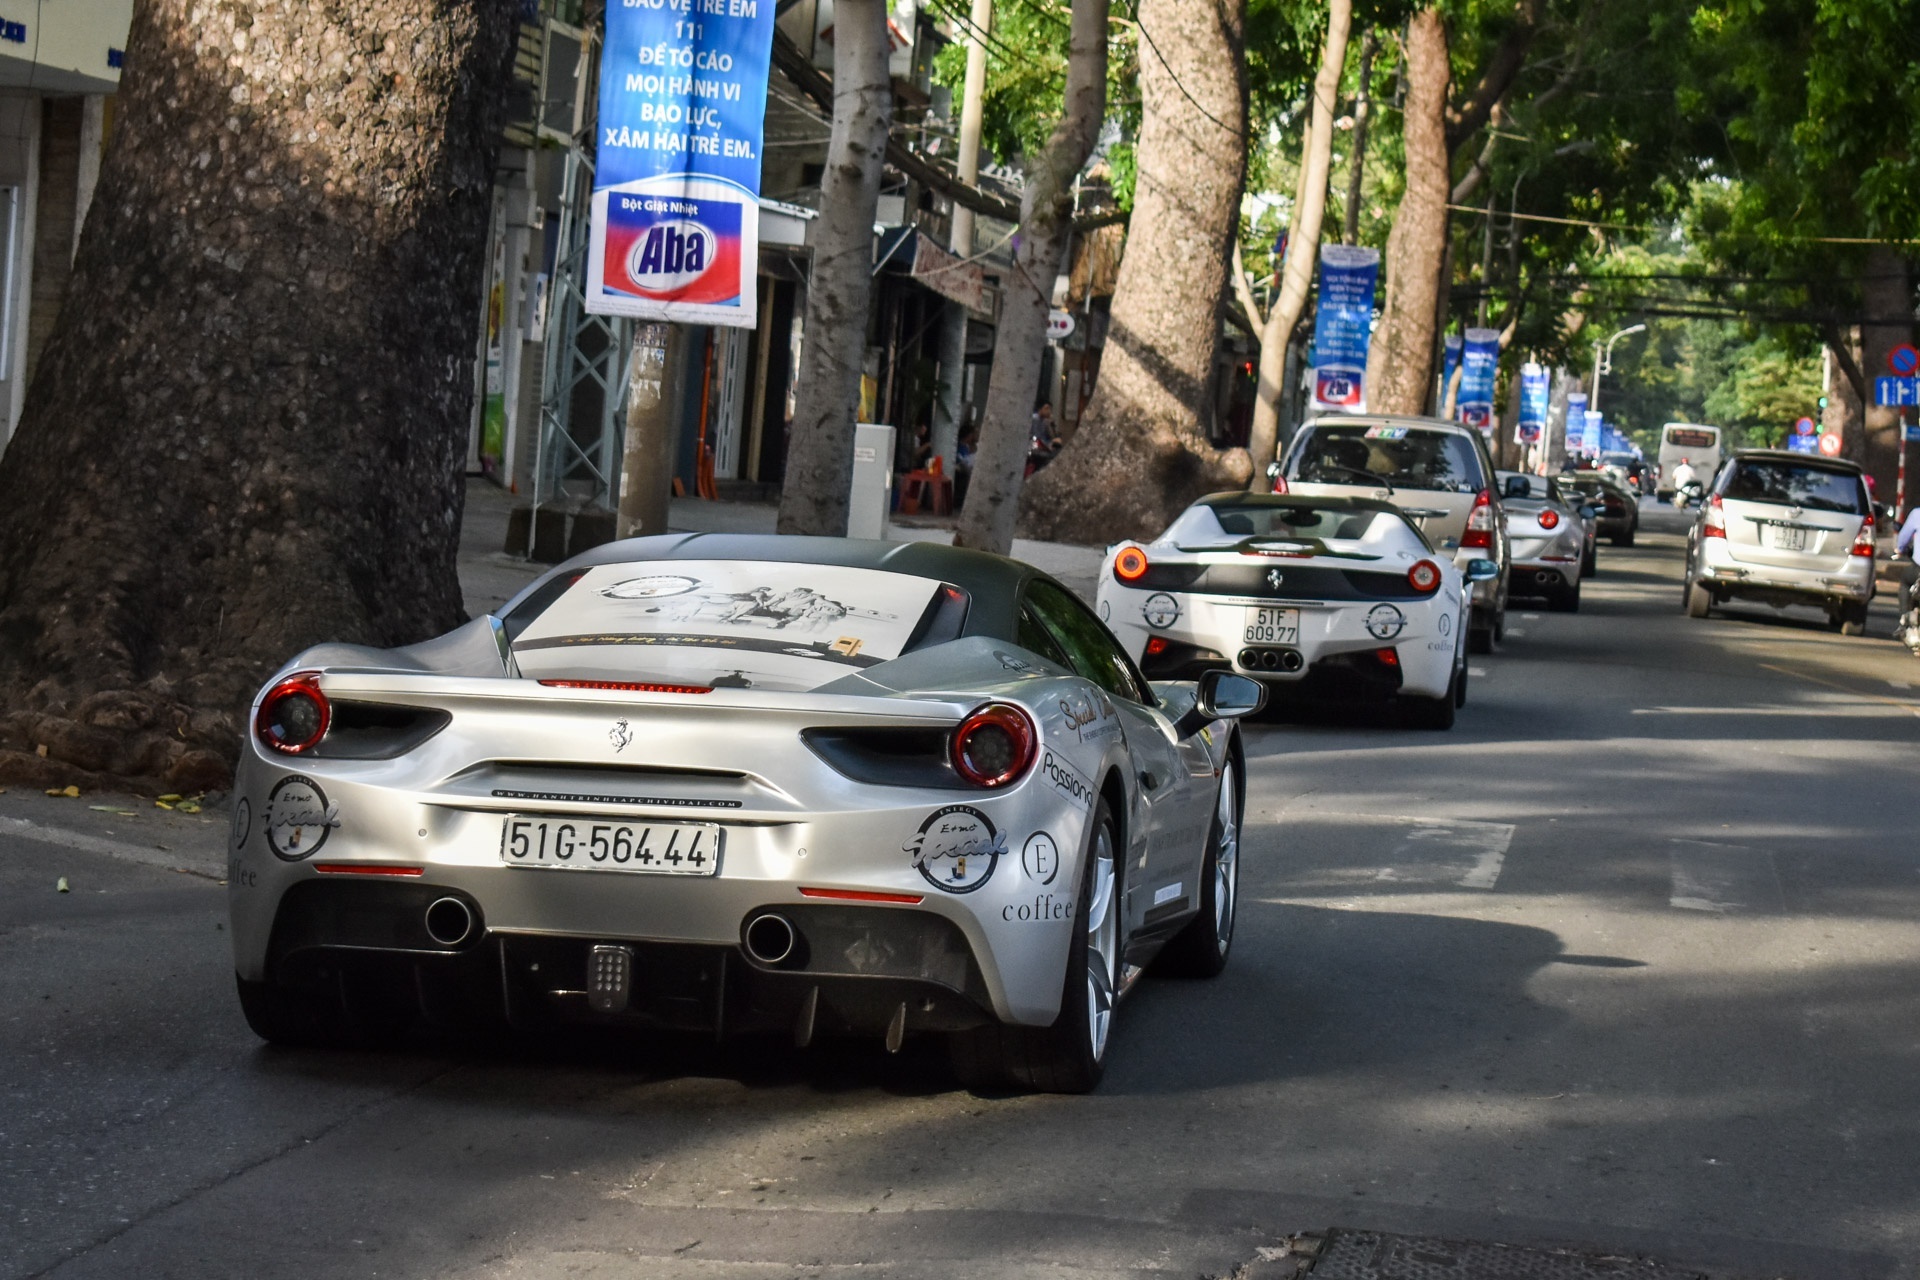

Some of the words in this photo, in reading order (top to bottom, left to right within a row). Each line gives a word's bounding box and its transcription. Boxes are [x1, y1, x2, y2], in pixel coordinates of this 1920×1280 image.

[729, 0, 757, 18] EM
[675, 20, 703, 40] 111
[639, 42, 667, 66] ĐỂ
[669, 45, 694, 67] TỐ
[696, 49, 733, 72] CÁO
[626, 74, 664, 98] MỌI
[669, 74, 719, 99] HÀNH
[723, 82, 741, 101] VI
[641, 103, 681, 127] BẠO
[685, 106, 722, 130] LỰC,
[605, 126, 649, 149] XÂM
[654, 131, 687, 156] HẠI
[690, 132, 720, 155] TRẺ
[724, 139, 756, 159] EM.
[622, 198, 642, 212] Bột
[644, 200, 668, 214] Giặt
[670, 201, 698, 217] Nhiệt
[638, 226, 705, 274] Aba
[1258, 609, 1286, 626] 51F
[1246, 625, 1296, 643] 609.77
[939, 806, 977, 815] ENERGY
[509, 822, 707, 868] 51G-564.44
[1035, 844, 1048, 874] E
[1002, 894, 1073, 922] coffee
